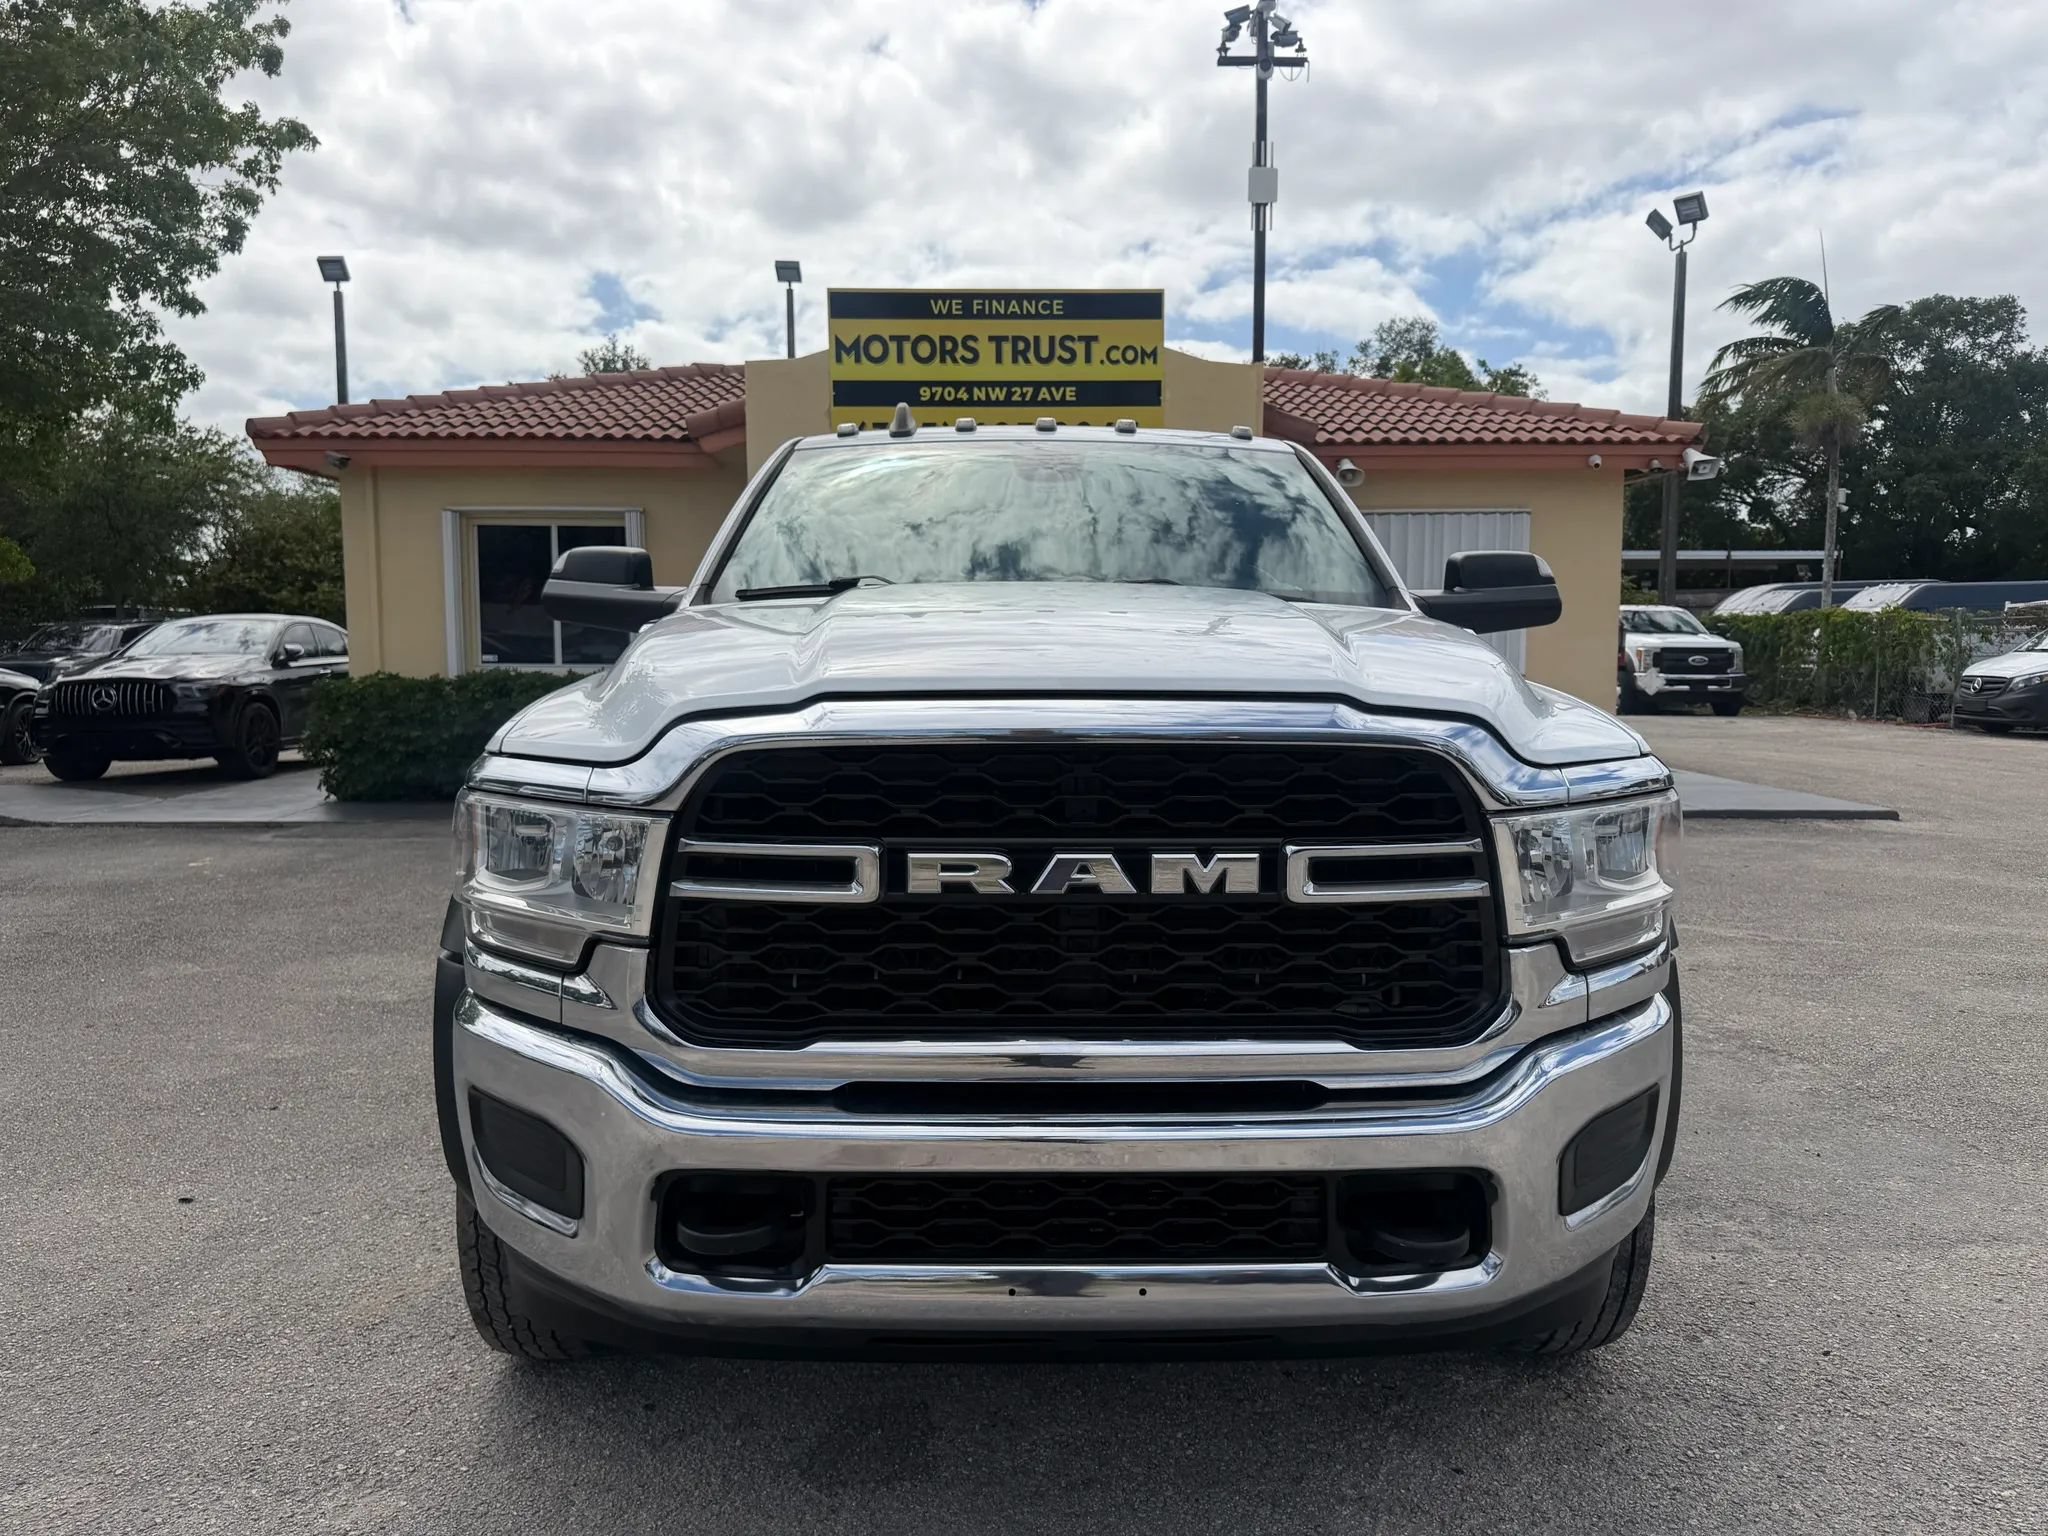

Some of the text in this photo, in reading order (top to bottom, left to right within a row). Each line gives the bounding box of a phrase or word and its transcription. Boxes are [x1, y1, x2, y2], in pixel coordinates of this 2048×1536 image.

[929, 299, 1065, 315] WE FINANCE
[834, 334, 980, 365] MOTORS
[920, 386, 1077, 402] 9704 NW 27 AVE
[906, 852, 1261, 895] RAM
